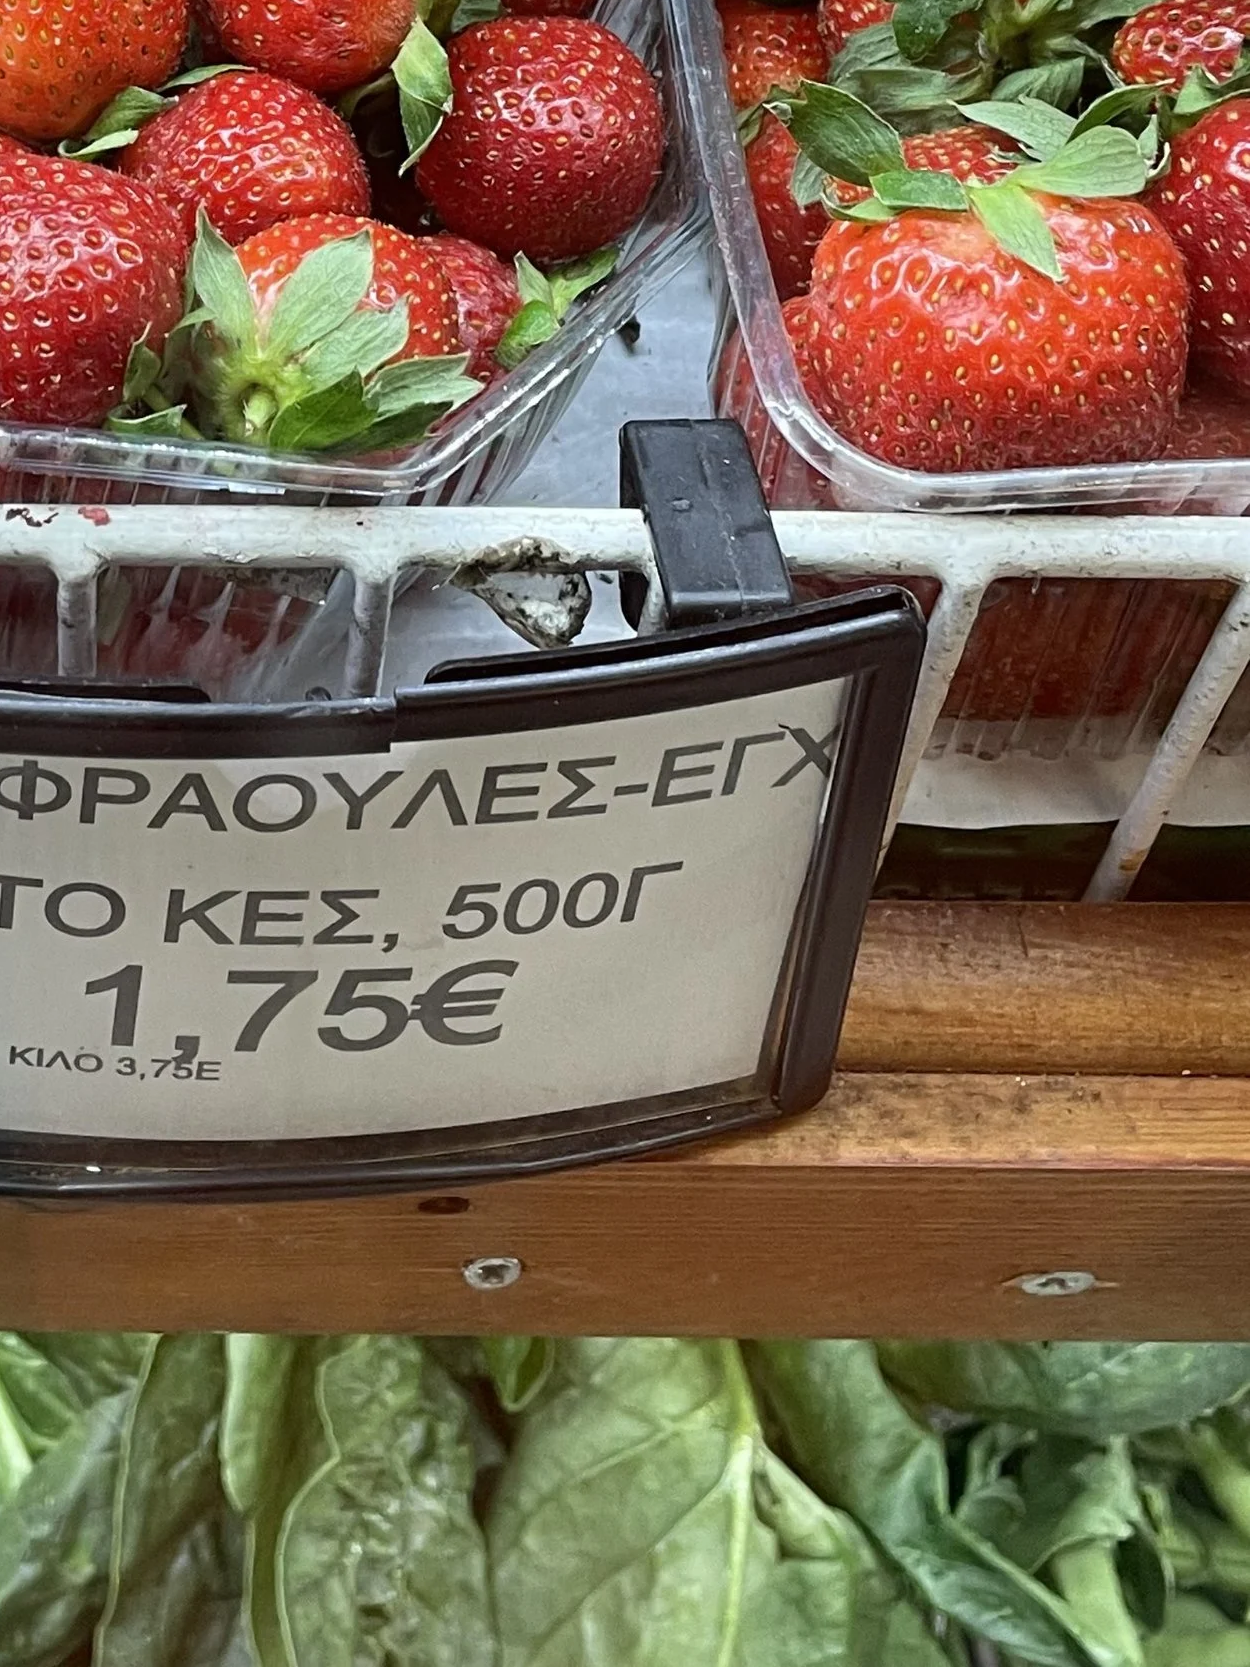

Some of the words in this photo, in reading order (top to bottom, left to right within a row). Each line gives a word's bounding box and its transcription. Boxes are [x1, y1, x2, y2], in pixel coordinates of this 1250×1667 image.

[163, 888, 400, 954] ΚΕΣ,
[441, 862, 685, 941] 500Γ
[84, 959, 520, 1064] 1,75€
[8, 1045, 104, 1074] ΚΙΛΟ
[115, 1056, 223, 1082] 3,75Ε
